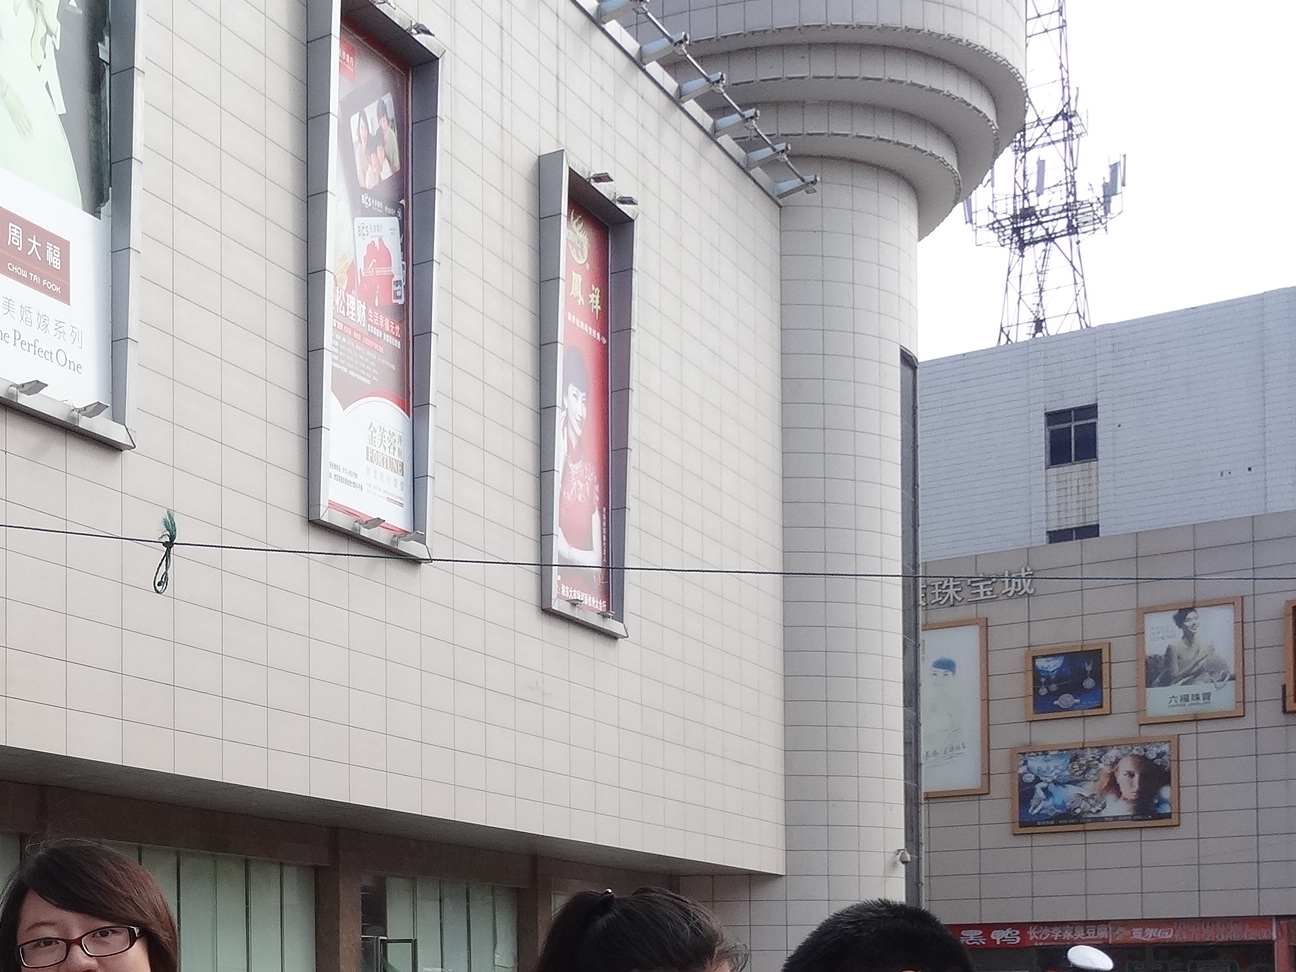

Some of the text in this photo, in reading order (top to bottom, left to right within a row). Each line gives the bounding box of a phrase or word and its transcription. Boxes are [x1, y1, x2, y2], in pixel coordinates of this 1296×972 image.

[7, 222, 61, 270] 周大福
[7, 262, 62, 294] CHOW TAI FOOK
[332, 286, 366, 328] 松理财
[13, 328, 54, 363] Perfect
[55, 348, 83, 375] One
[919, 566, 1035, 607] 珠宝城
